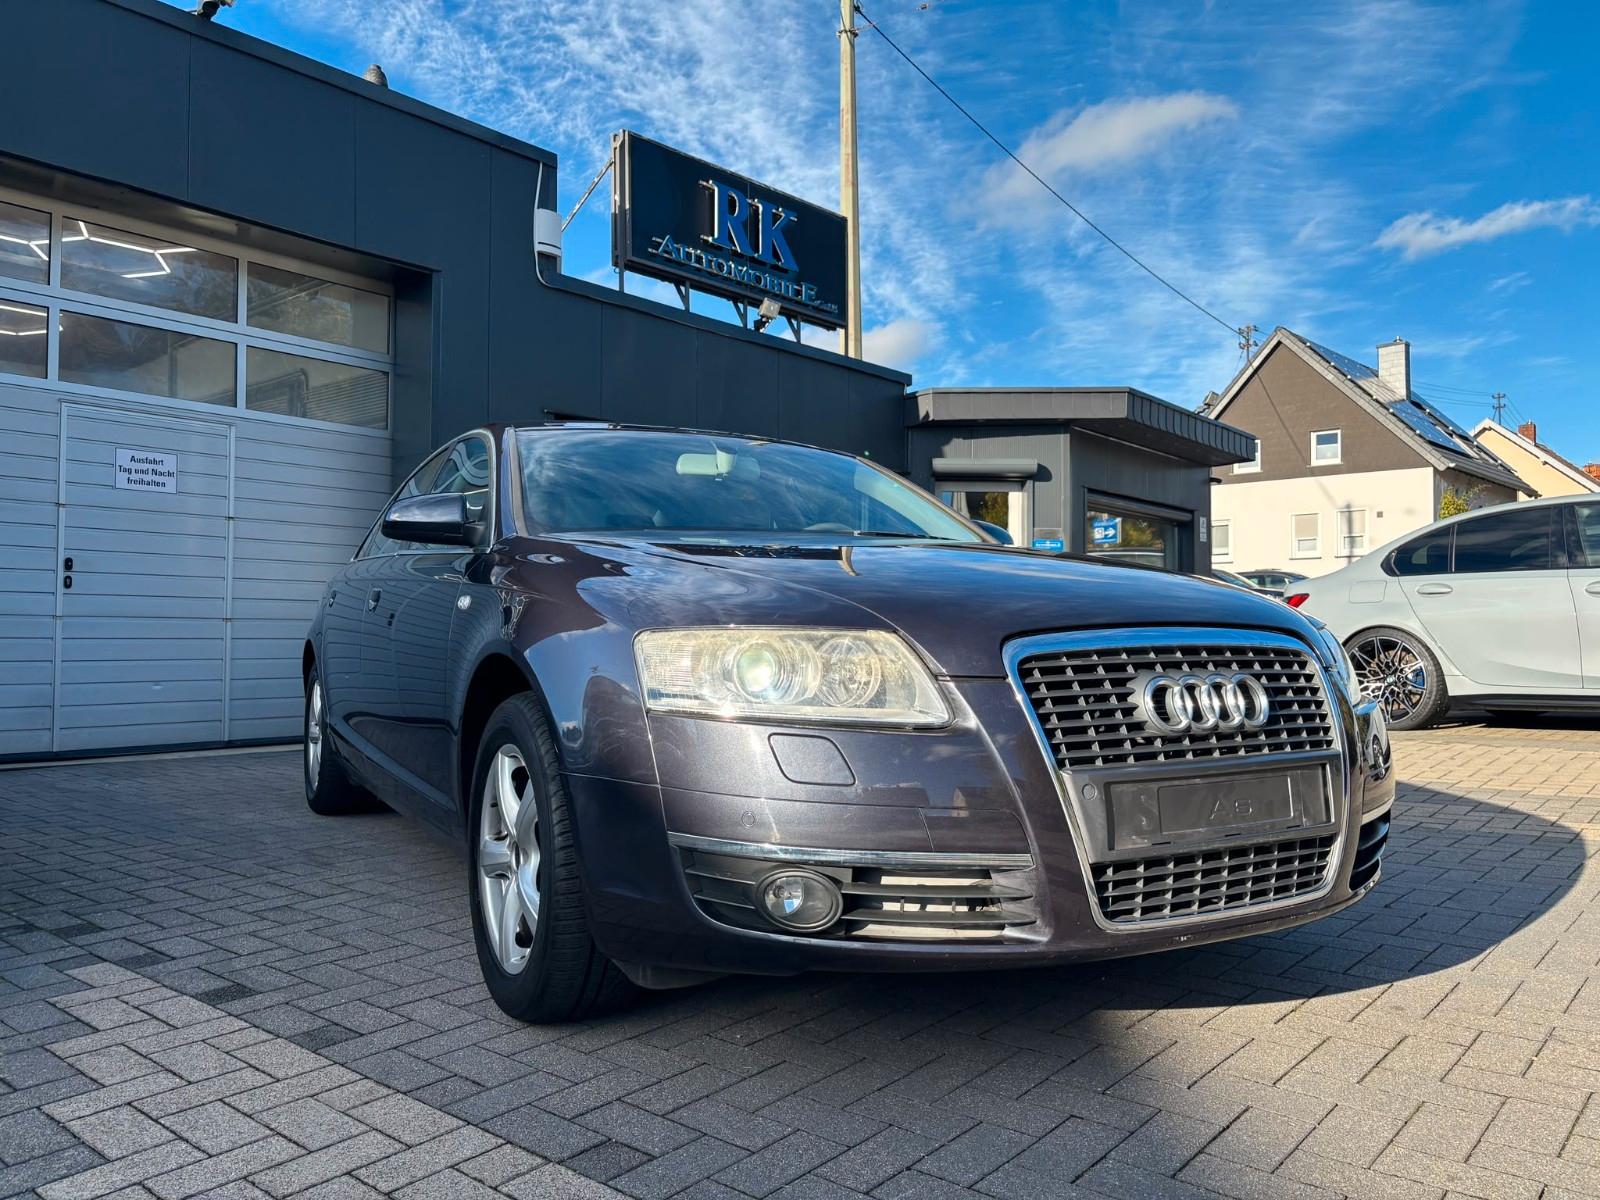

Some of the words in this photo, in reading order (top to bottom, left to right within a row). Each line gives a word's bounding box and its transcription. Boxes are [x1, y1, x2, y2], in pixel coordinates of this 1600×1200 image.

[699, 178, 799, 272] RK
[130, 455, 164, 466] Ausfahrt
[118, 465, 132, 475] Tag
[151, 468, 175, 477] Nacht
[127, 477, 166, 487] freihalten
